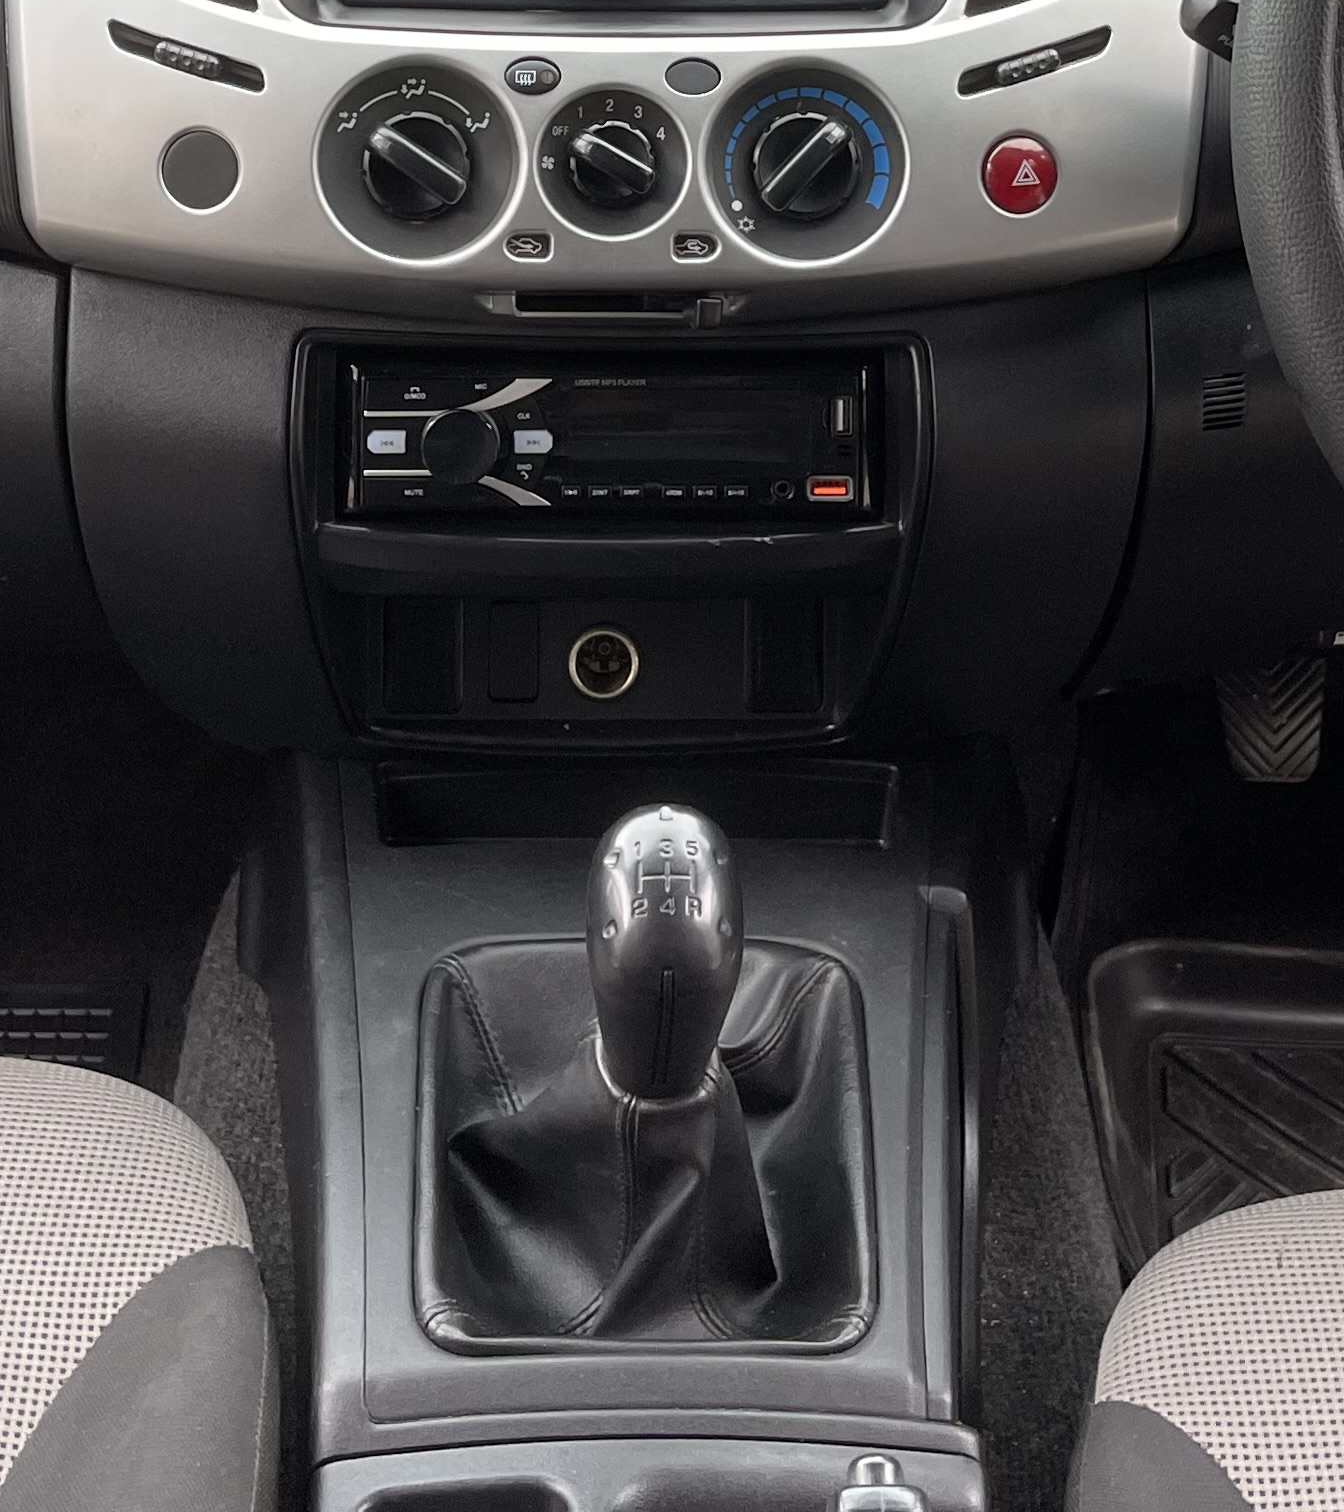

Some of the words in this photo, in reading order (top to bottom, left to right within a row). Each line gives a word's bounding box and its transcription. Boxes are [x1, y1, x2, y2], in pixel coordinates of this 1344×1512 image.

[605, 99, 614, 112] 2
[578, 106, 584, 119] 1
[634, 106, 643, 119] 3
[552, 126, 569, 136] OFF
[656, 126, 666, 141] 4
[617, 378, 647, 386] PLAYER
[634, 840, 642, 859] 1
[659, 838, 674, 858] 3
[685, 840, 699, 858] 5
[631, 897, 648, 919] 2
[659, 896, 676, 916] 4
[684, 895, 702, 919] R
